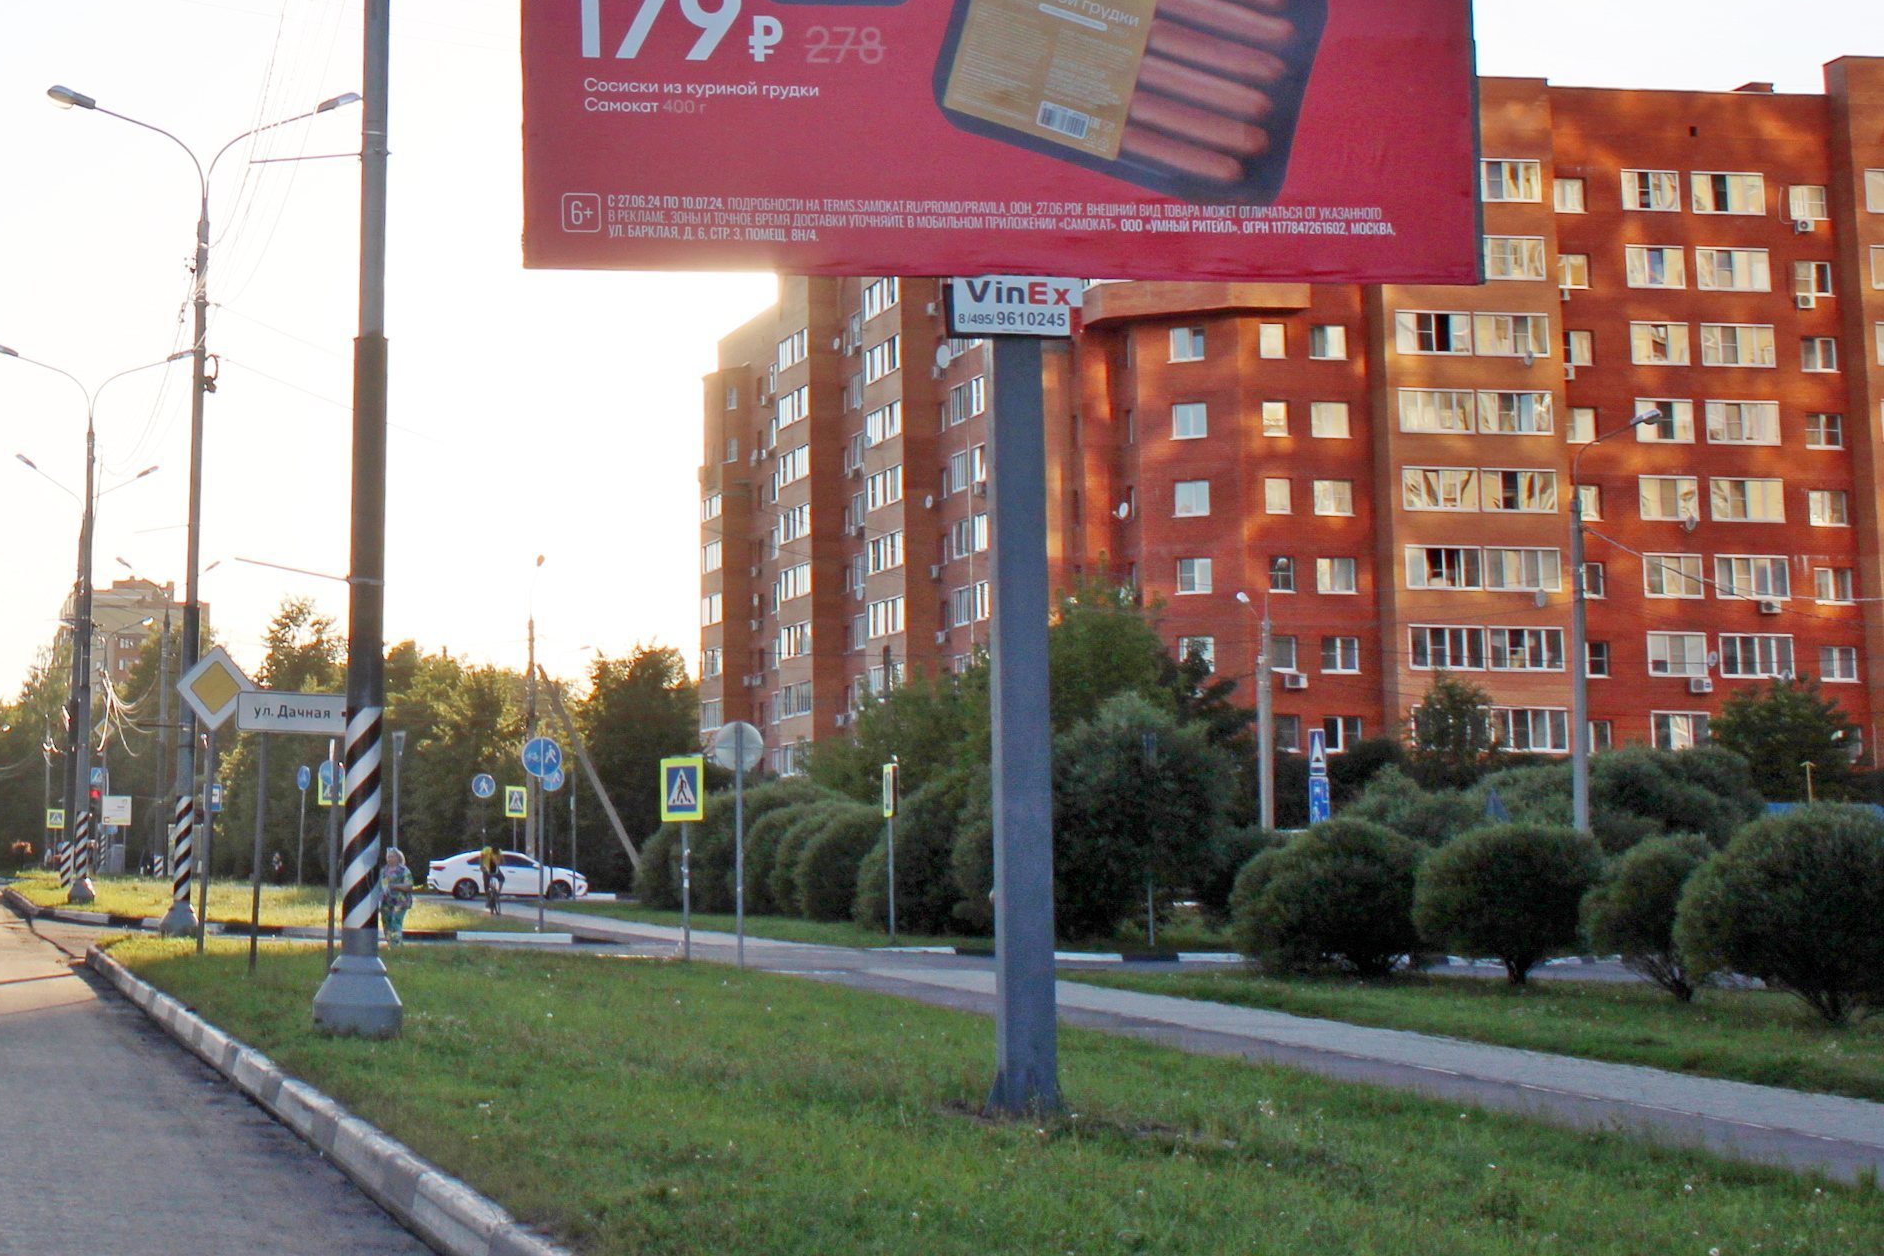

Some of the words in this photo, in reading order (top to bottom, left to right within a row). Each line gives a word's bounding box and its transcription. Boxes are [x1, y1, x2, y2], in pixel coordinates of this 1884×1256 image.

[1082, 0, 1140, 28] грудки
[805, 25, 887, 65] 278
[583, 77, 659, 94] Сосиски
[663, 82, 682, 94] из
[686, 81, 758, 100] куриной
[762, 85, 820, 100] грудки
[583, 97, 659, 114] Самокат
[662, 100, 696, 114] 400
[699, 102, 707, 114] г
[570, 200, 594, 226] 6+
[607, 194, 616, 208] С
[618, 195, 661, 209] 27.06.24
[664, 196, 679, 209] ПО
[683, 196, 725, 210] 10.07.24.
[728, 198, 804, 213] ПОДРОБНОСТИ
[807, 200, 820, 212] НА
[1087, 202, 1137, 218] ВНЕШНИЙ
[1139, 205, 1162, 219] ВИД
[1164, 204, 1201, 218] ТОВАРА
[1203, 205, 1237, 219] МОЖЕТ
[1239, 206, 1303, 220] ОТЛИЧАТЬСЯ
[1305, 207, 1317, 220] ОТ
[1319, 207, 1381, 220] УКАЗАННОГО
[608, 211, 616, 222] В
[671, 212, 700, 224] ЗОНЫ
[703, 213, 712, 224] И
[715, 212, 752, 225] ТОЧНОЕ
[755, 213, 790, 226] ВРЕМЯ
[793, 213, 846, 227] ДОСТАВКИ
[849, 213, 904, 227] УТОЧНЯЙТЕ
[907, 216, 915, 227] В
[917, 216, 982, 228] МОБИЛЬНОМ
[985, 217, 1056, 229] ПРИЛОЖЕНИИ
[1146, 219, 1190, 233] «УМНЫЙ
[1243, 221, 1269, 233] ОГРН
[608, 226, 624, 238] УЛ.
[965, 279, 1071, 306] VinEx
[254, 707, 274, 719] ул.
[277, 705, 331, 719] Дачная
